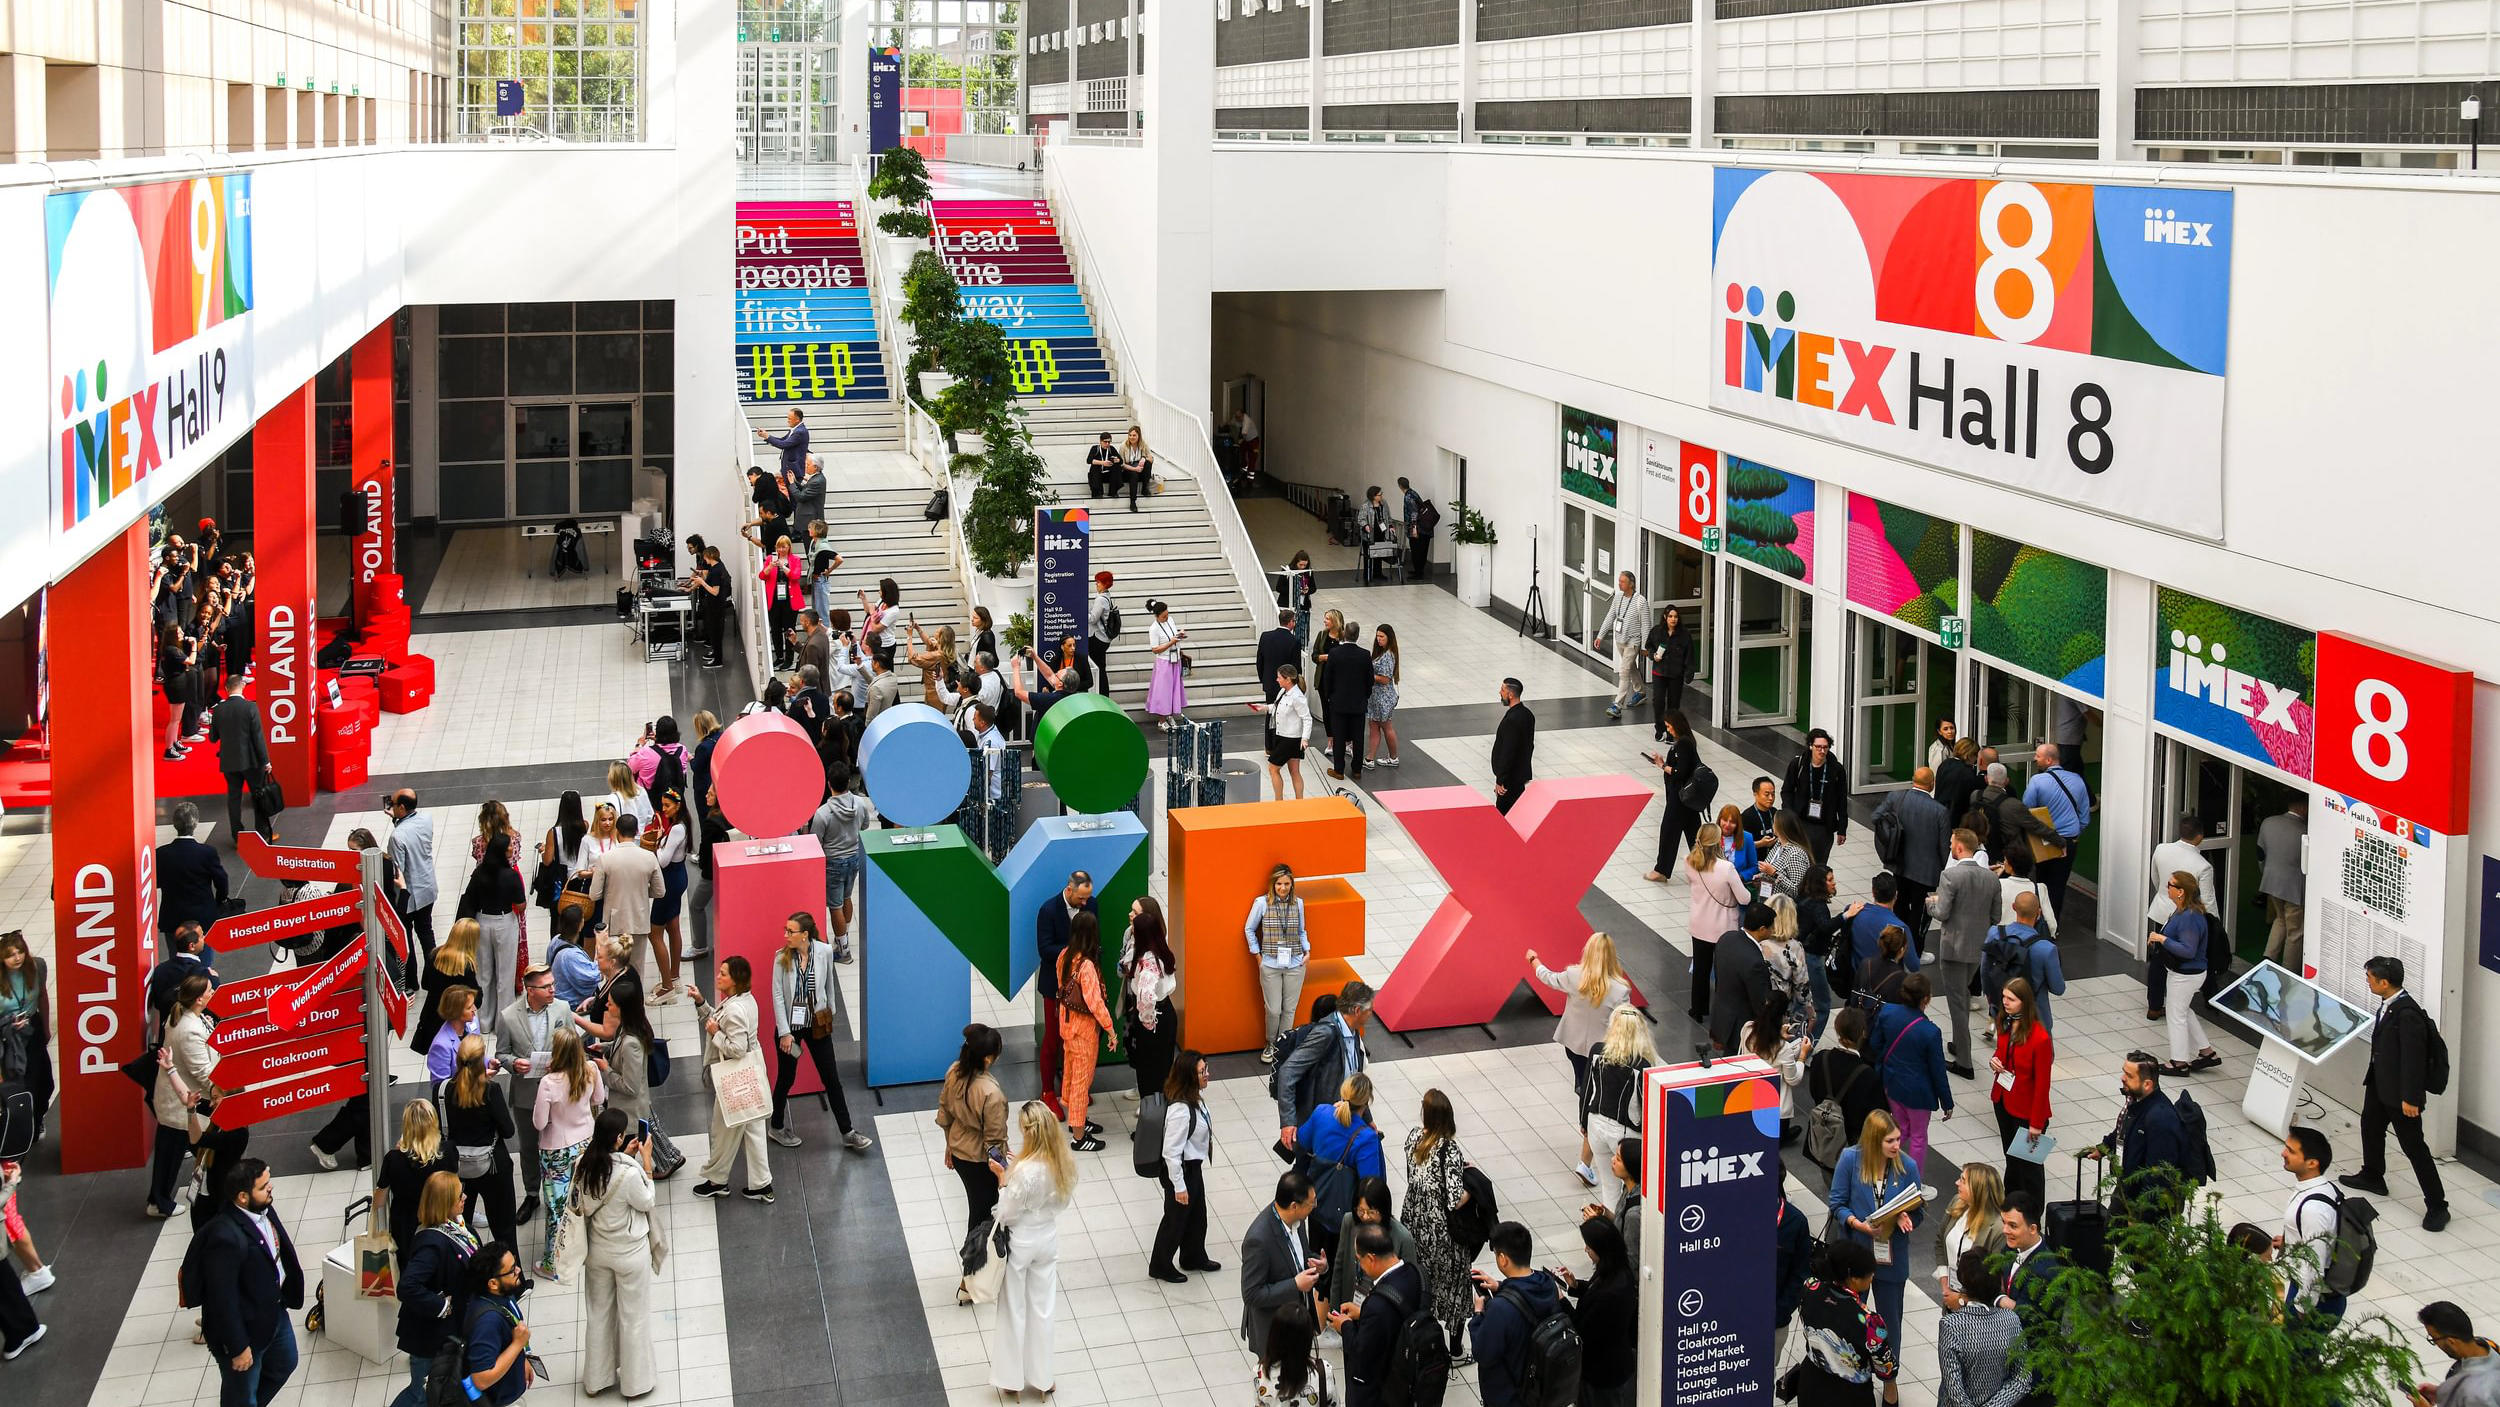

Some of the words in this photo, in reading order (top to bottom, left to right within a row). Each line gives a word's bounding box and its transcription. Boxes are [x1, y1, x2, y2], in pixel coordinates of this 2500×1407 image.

[737, 225, 792, 255] Put
[939, 223, 1019, 252] Lead
[191, 176, 216, 335] 9
[1975, 181, 2055, 343] 8
[740, 258, 852, 297] people
[948, 256, 1003, 285] the
[742, 300, 821, 332] first.
[959, 296, 1033, 326] way.
[752, 343, 855, 399] KEEP
[167, 352, 210, 459] Hall
[214, 347, 226, 423] 9
[1908, 351, 2039, 459] Hall
[2067, 382, 2114, 475] 8
[1688, 462, 1711, 523] 8
[269, 605, 296, 744] POLAND
[2351, 678, 2409, 782] 8
[2351, 811, 2364, 822] Hall
[2366, 816, 2378, 826] 8.0
[2396, 818, 2408, 839] 8
[276, 855, 336, 870] Registration
[229, 921, 270, 939] Hosted
[273, 914, 307, 929] Buyer
[309, 905, 351, 921] Lounge
[74, 863, 119, 1075] POLAND
[291, 972, 334, 1012] Well-being
[335, 948, 363, 976] Lounge
[231, 988, 261, 1004] IMEX
[216, 1023, 279, 1045] Lufthansa
[310, 1007, 339, 1023] Drop
[262, 1047, 329, 1069] Cloakroom
[2256, 1057, 2292, 1083] popshap
[263, 1091, 293, 1109] Food
[296, 1082, 331, 1100] Court
[1679, 1239, 1701, 1254] Hall
[1703, 1236, 1721, 1250] 8.0
[1677, 1333, 1737, 1351] Cloakroom
[1678, 1322, 1699, 1338] Hall
[1701, 1320, 1718, 1333] 9.0
[1677, 1349, 1705, 1365] Food
[1707, 1343, 1745, 1360] Market
[1677, 1361, 1717, 1379] Hosted
[1719, 1358, 1751, 1371] Buyer
[1676, 1386, 1734, 1406] Inspiration
[1736, 1380, 1759, 1394] Hub
[1677, 1376, 1718, 1391] Lounge
